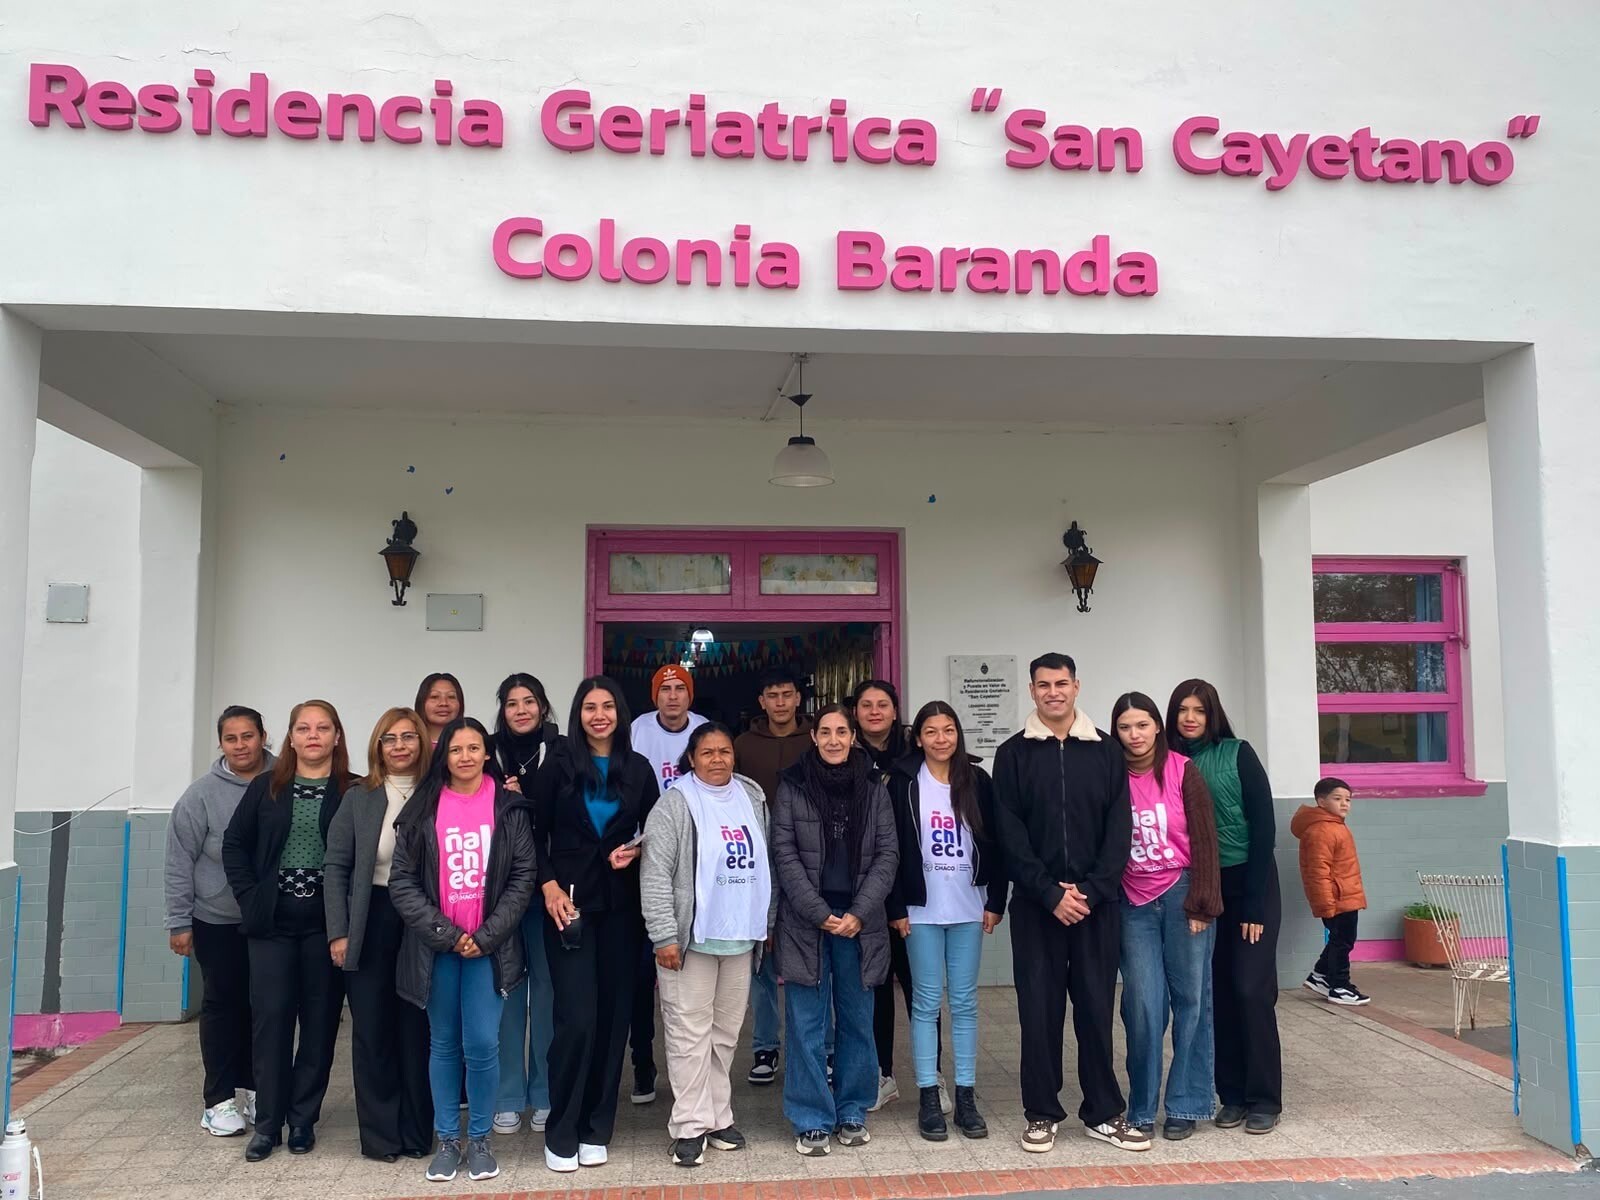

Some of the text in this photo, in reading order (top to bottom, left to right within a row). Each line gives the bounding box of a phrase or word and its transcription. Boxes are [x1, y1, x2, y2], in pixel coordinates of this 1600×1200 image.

[28, 64, 1539, 191] Residencia Geriatrica "San Cayetano"
[492, 217, 1159, 296] Colonia Baranda
